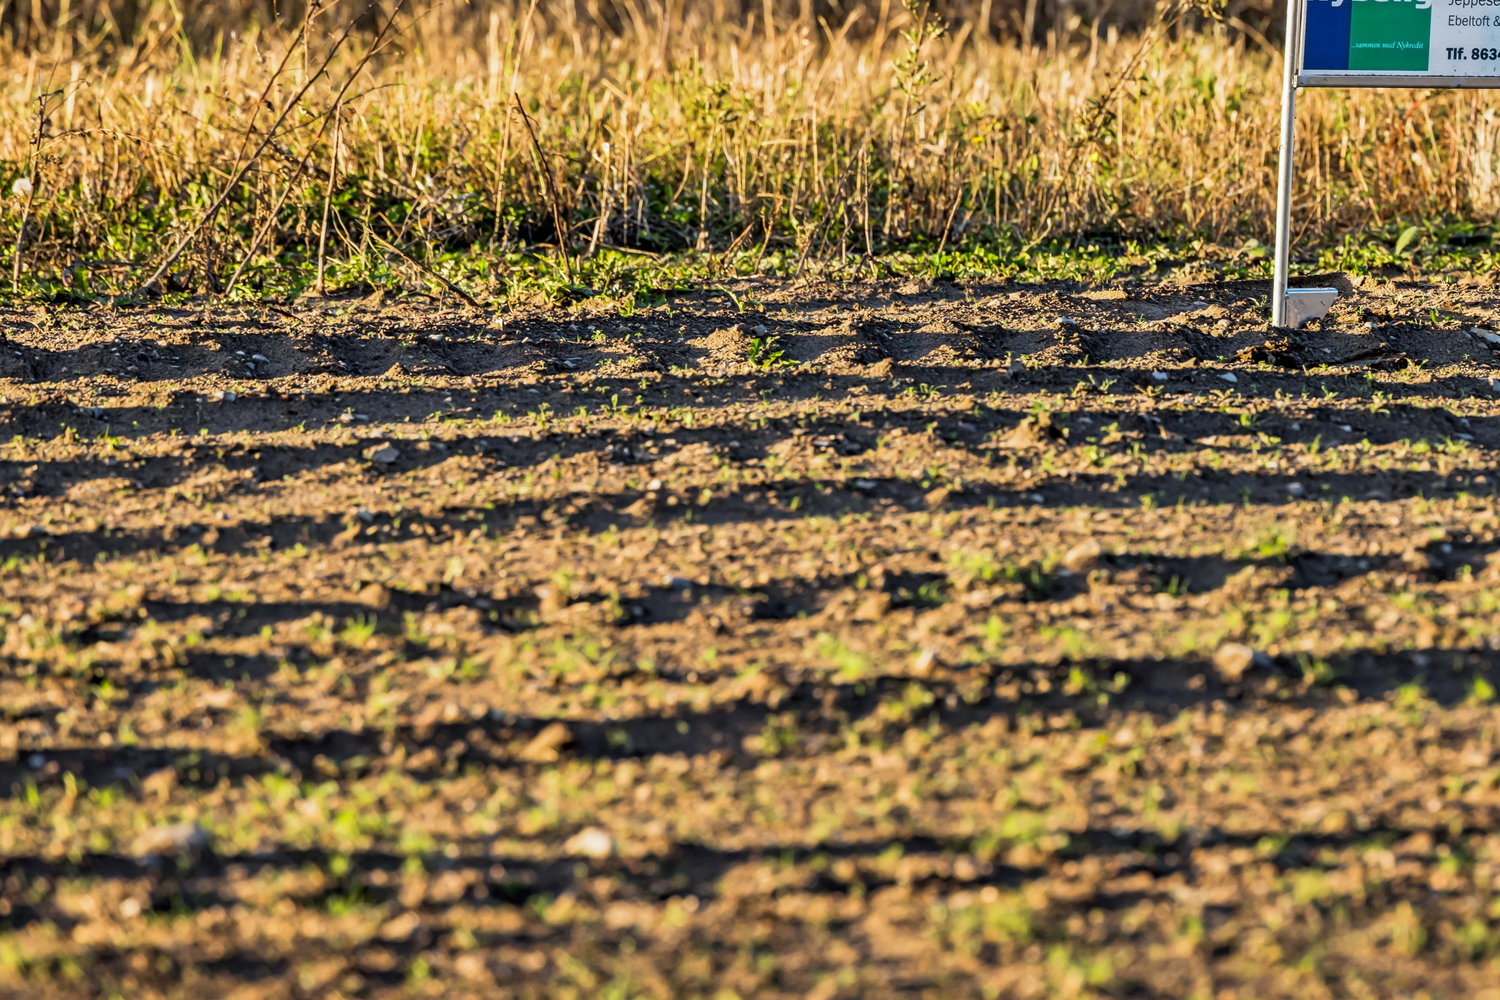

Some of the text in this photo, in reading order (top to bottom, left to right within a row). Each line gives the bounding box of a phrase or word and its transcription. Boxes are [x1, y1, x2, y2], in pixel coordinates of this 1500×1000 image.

[1448, 15, 1490, 27] Ebeltoft
[1382, 41, 1395, 49] med
[1446, 47, 1467, 61] Tlf.
